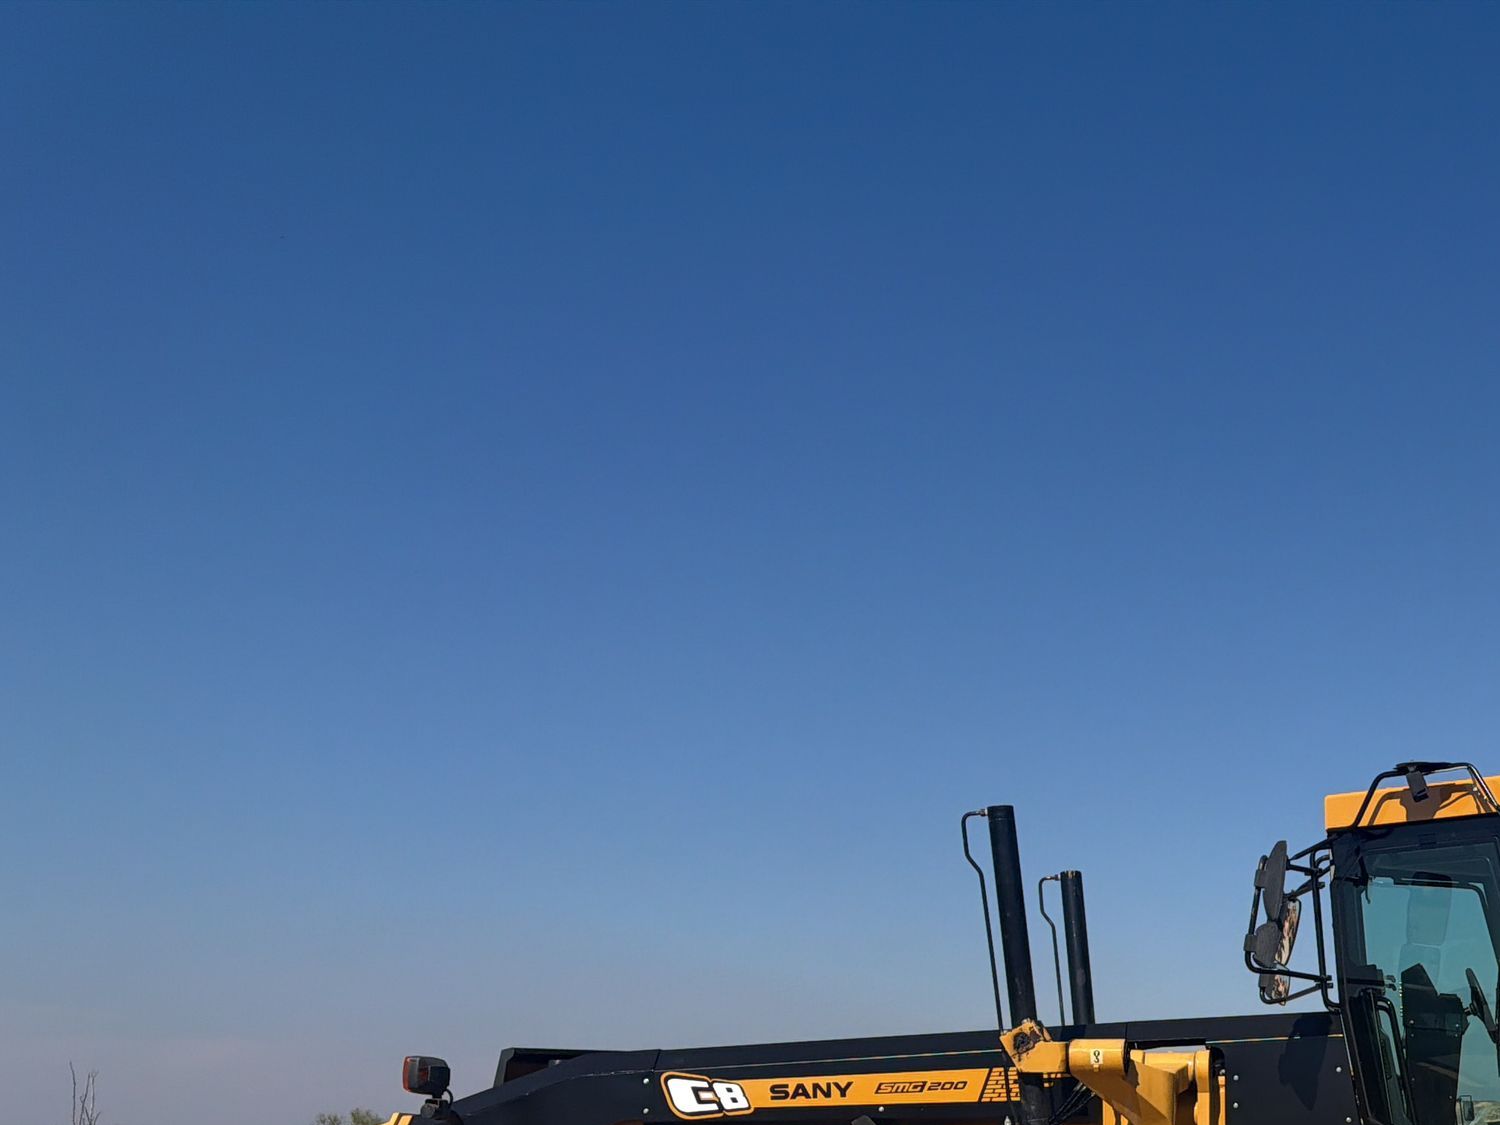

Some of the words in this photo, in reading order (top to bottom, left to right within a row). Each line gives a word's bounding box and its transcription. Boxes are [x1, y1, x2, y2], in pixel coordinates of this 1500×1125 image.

[770, 1081, 853, 1101] SANY
[876, 1081, 926, 1094] SMG
[927, 1081, 967, 1092] 200
